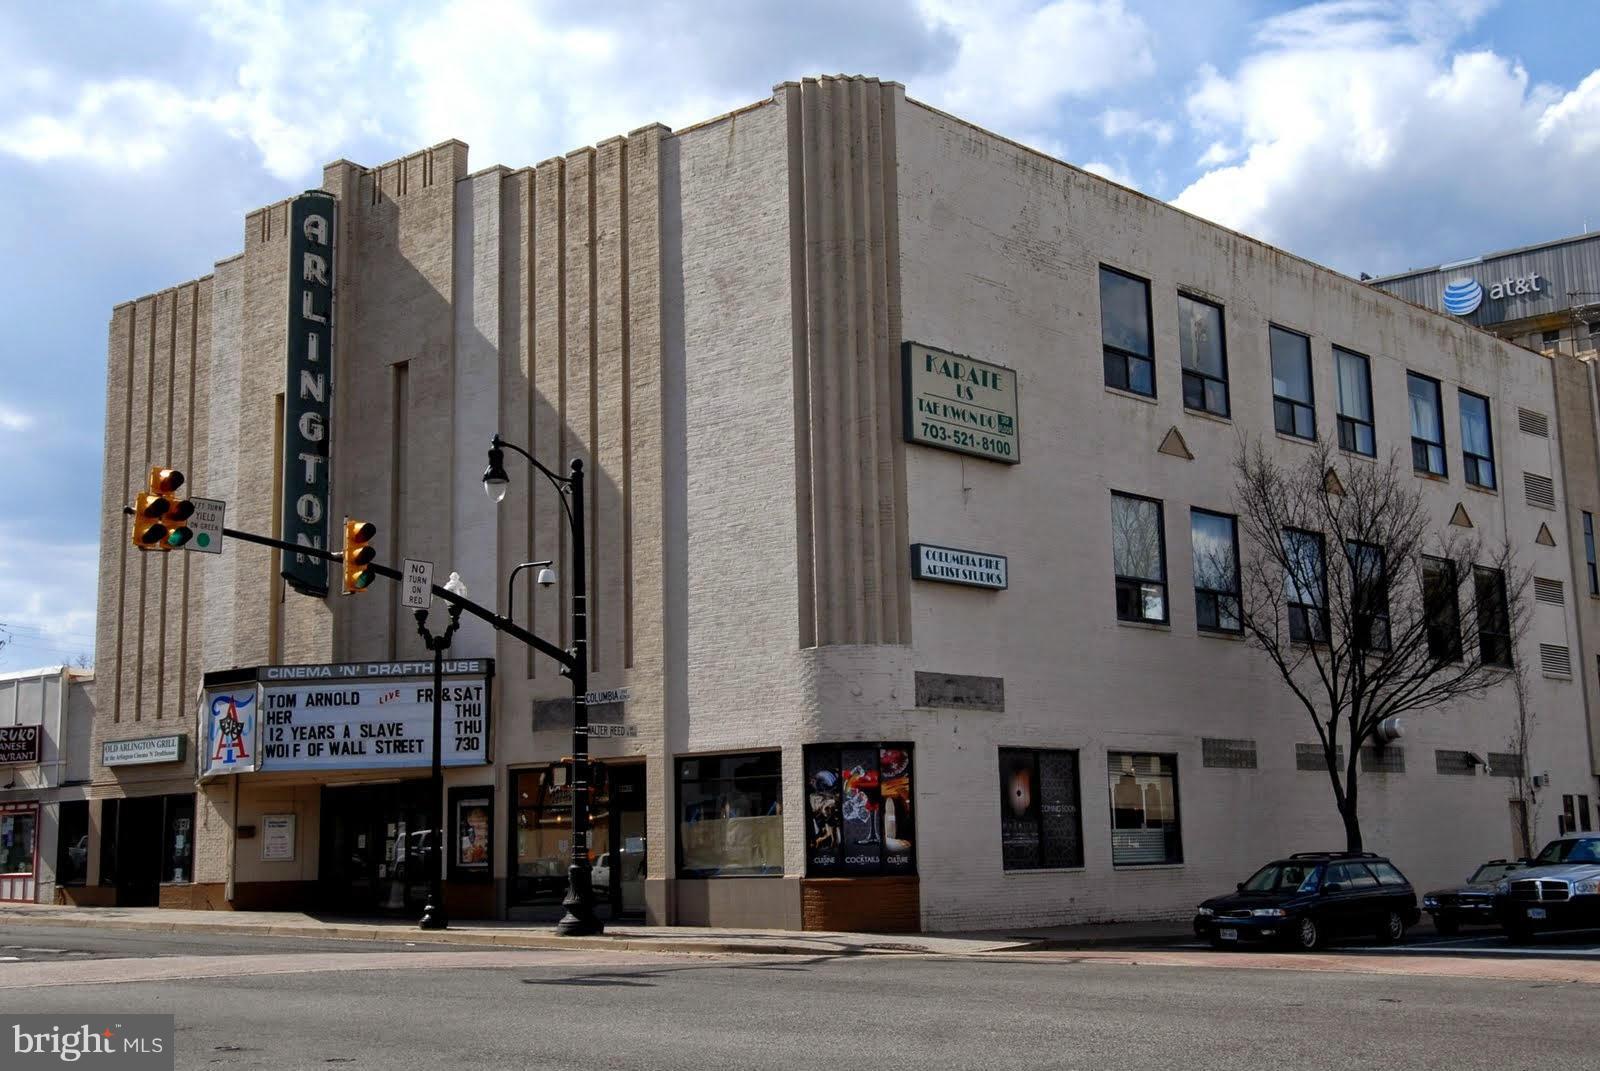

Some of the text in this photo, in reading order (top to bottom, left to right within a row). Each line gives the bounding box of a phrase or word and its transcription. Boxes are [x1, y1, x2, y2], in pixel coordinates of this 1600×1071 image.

[1489, 272, 1541, 299] at&t
[925, 354, 1004, 391] KARATE
[296, 214, 328, 565] ARLINGTON
[956, 384, 974, 400] US
[921, 422, 1011, 456] 703-521-8100
[207, 503, 223, 512] TURN
[196, 511, 216, 522] YIELD
[200, 523, 219, 531] GREEN
[925, 549, 1001, 570] COLUMBIA PIKE
[411, 564, 426, 574] NO
[926, 565, 1002, 584] ARTIST STUDIOS
[408, 575, 427, 585] TURN
[411, 586, 422, 594] ON
[408, 596, 423, 605] RED
[267, 666, 332, 678] CINEMA
[339, 664, 360, 676] 'N'
[267, 694, 297, 708] TOM
[305, 691, 360, 707] ARNOLD
[379, 690, 400, 704] LIVE
[585, 691, 619, 703] COLUMBIA
[266, 703, 481, 725] HER THU
[269, 720, 482, 741] 12 YEARS A SLAVE THU
[610, 726, 626, 736] REED
[105, 739, 176, 753] OLD ARLINGTON GRILL
[308, 742, 324, 757] OF
[329, 741, 366, 756] WALL
[375, 739, 424, 754] STREET
[455, 737, 480, 751] 730
[845, 855, 880, 865] COCKTAILS
